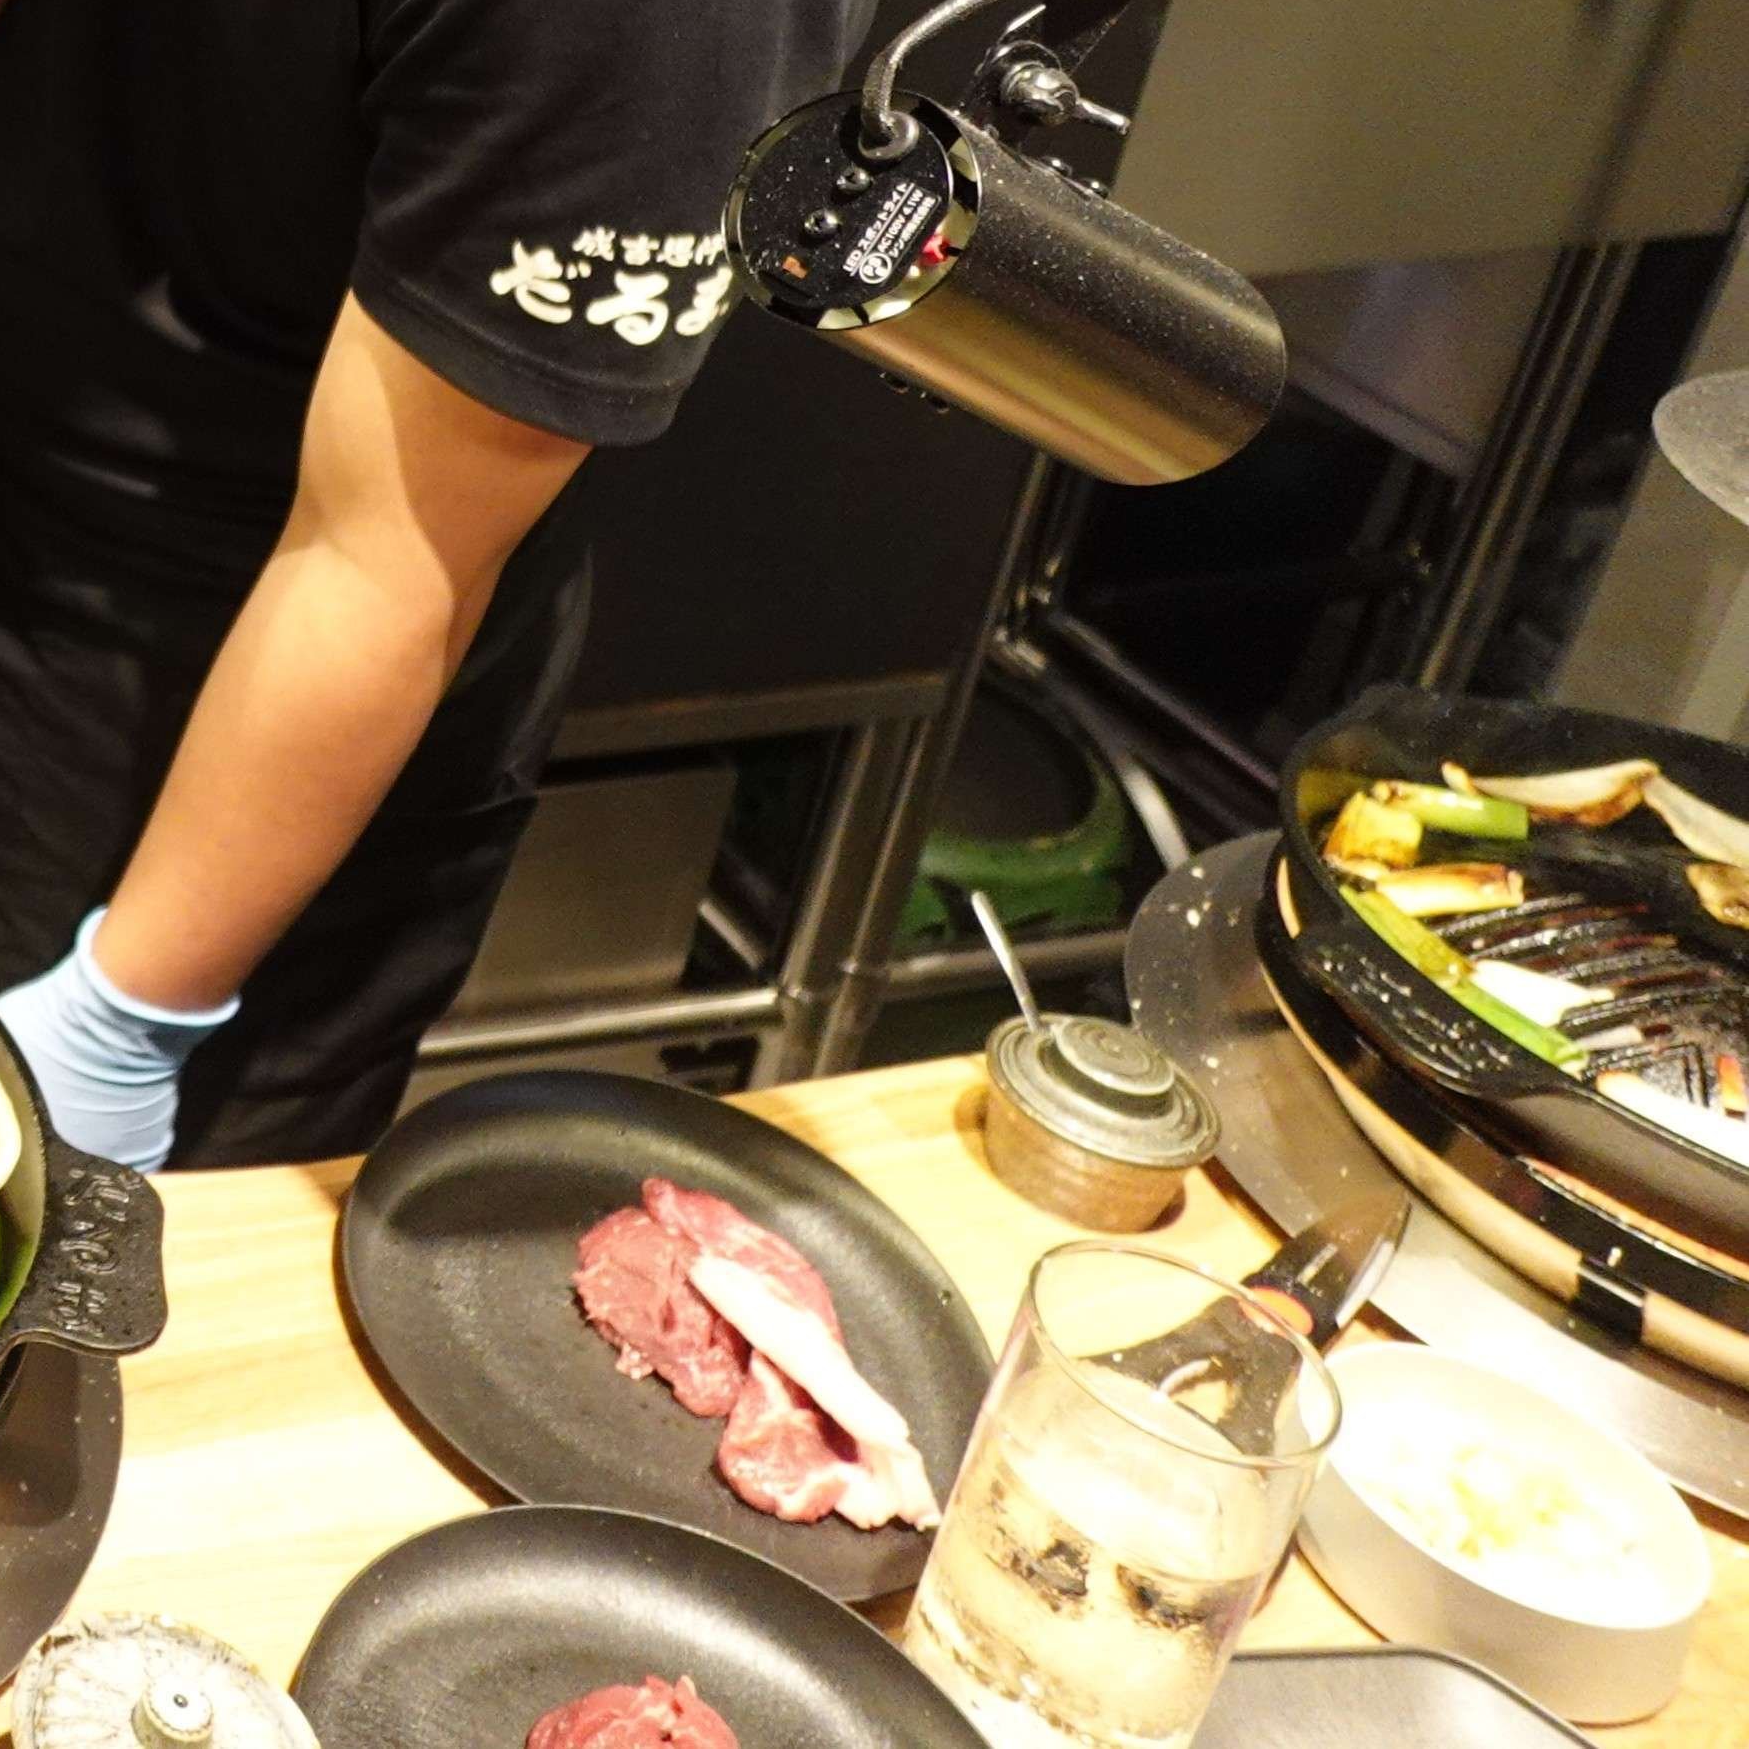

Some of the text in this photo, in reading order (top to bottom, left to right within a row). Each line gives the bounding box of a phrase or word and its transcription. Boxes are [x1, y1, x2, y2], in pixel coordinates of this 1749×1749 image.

[843, 182, 908, 273] LED スポットライト
